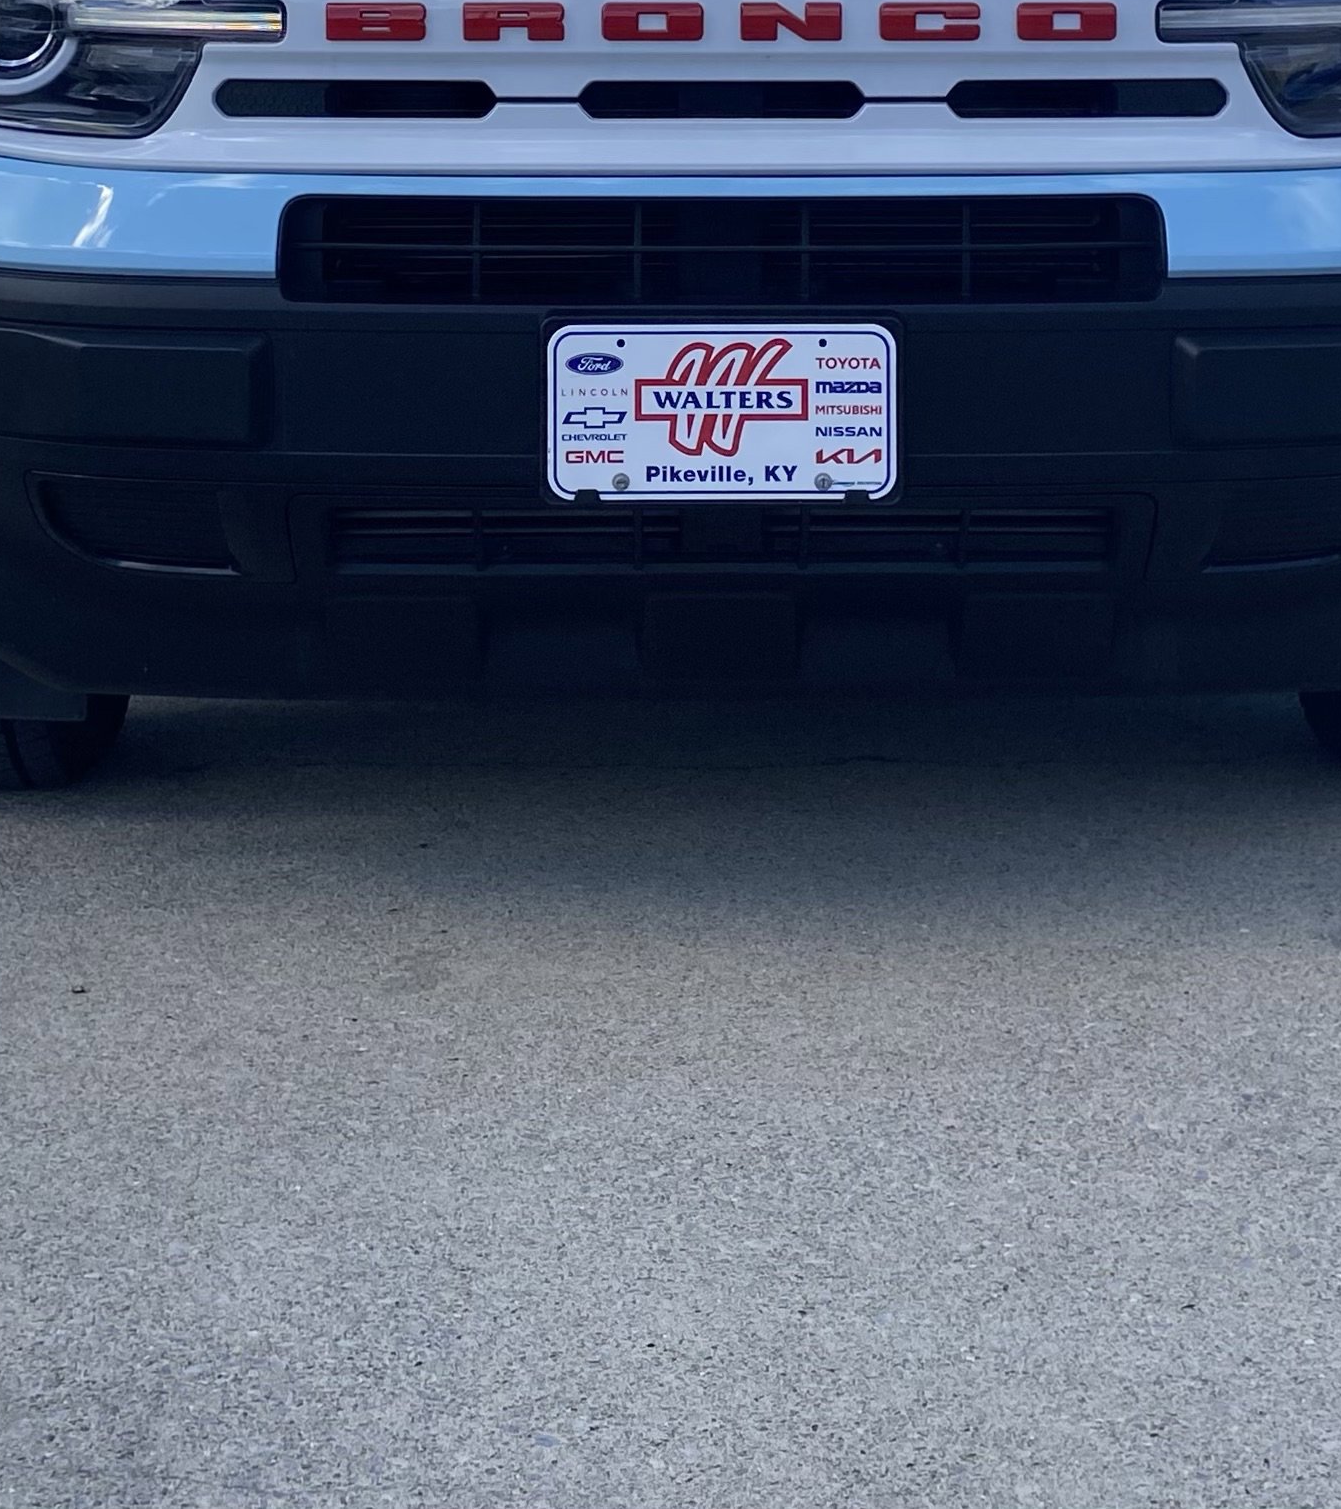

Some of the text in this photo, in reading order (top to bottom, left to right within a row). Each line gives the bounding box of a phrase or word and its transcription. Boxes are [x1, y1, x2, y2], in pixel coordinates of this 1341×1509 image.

[325, 1, 1118, 42] BRONCO
[577, 356, 612, 371] Ford
[815, 357, 882, 370] TOYOTA
[561, 388, 628, 397] LINCOLN
[652, 390, 794, 410] WALTERS
[815, 404, 883, 415] MITSUBISHI
[561, 433, 628, 442] CHEVROLET
[815, 426, 883, 437] NISSAN
[565, 450, 625, 464] GMC
[646, 465, 798, 486] Pikeville, KY
